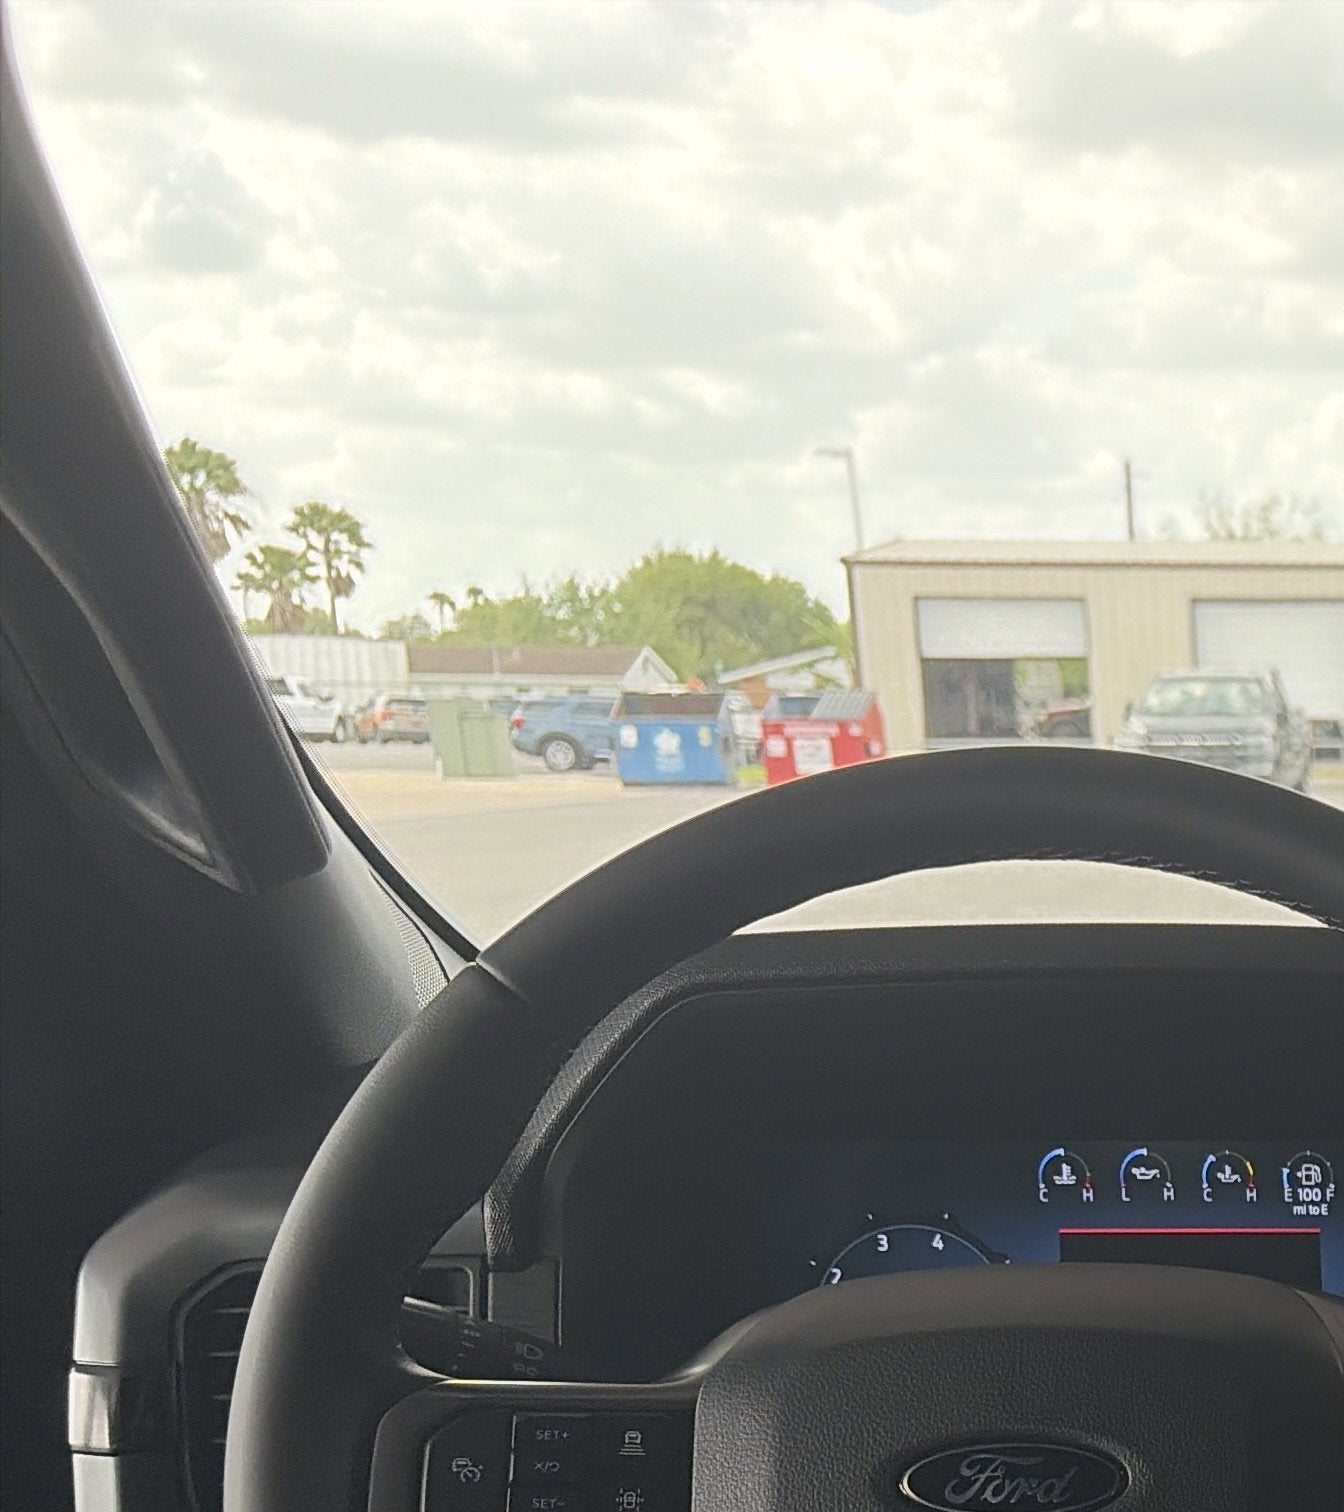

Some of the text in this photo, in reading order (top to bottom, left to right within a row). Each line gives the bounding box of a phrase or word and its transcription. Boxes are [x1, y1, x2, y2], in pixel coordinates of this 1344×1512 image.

[1039, 1188, 1048, 1202] C
[1083, 1188, 1094, 1202] H
[1122, 1188, 1130, 1202] L
[1163, 1188, 1174, 1201] H
[1203, 1188, 1213, 1202] C
[1246, 1188, 1257, 1202] H
[1285, 1188, 1293, 1202] E
[1297, 1188, 1322, 1202] 100
[1326, 1188, 1335, 1202] F
[1309, 1205, 1319, 1215] to
[1321, 1205, 1328, 1215] E
[876, 1234, 889, 1252] 3
[932, 1233, 944, 1251] 4
[945, 1453, 1079, 1504] Ford
